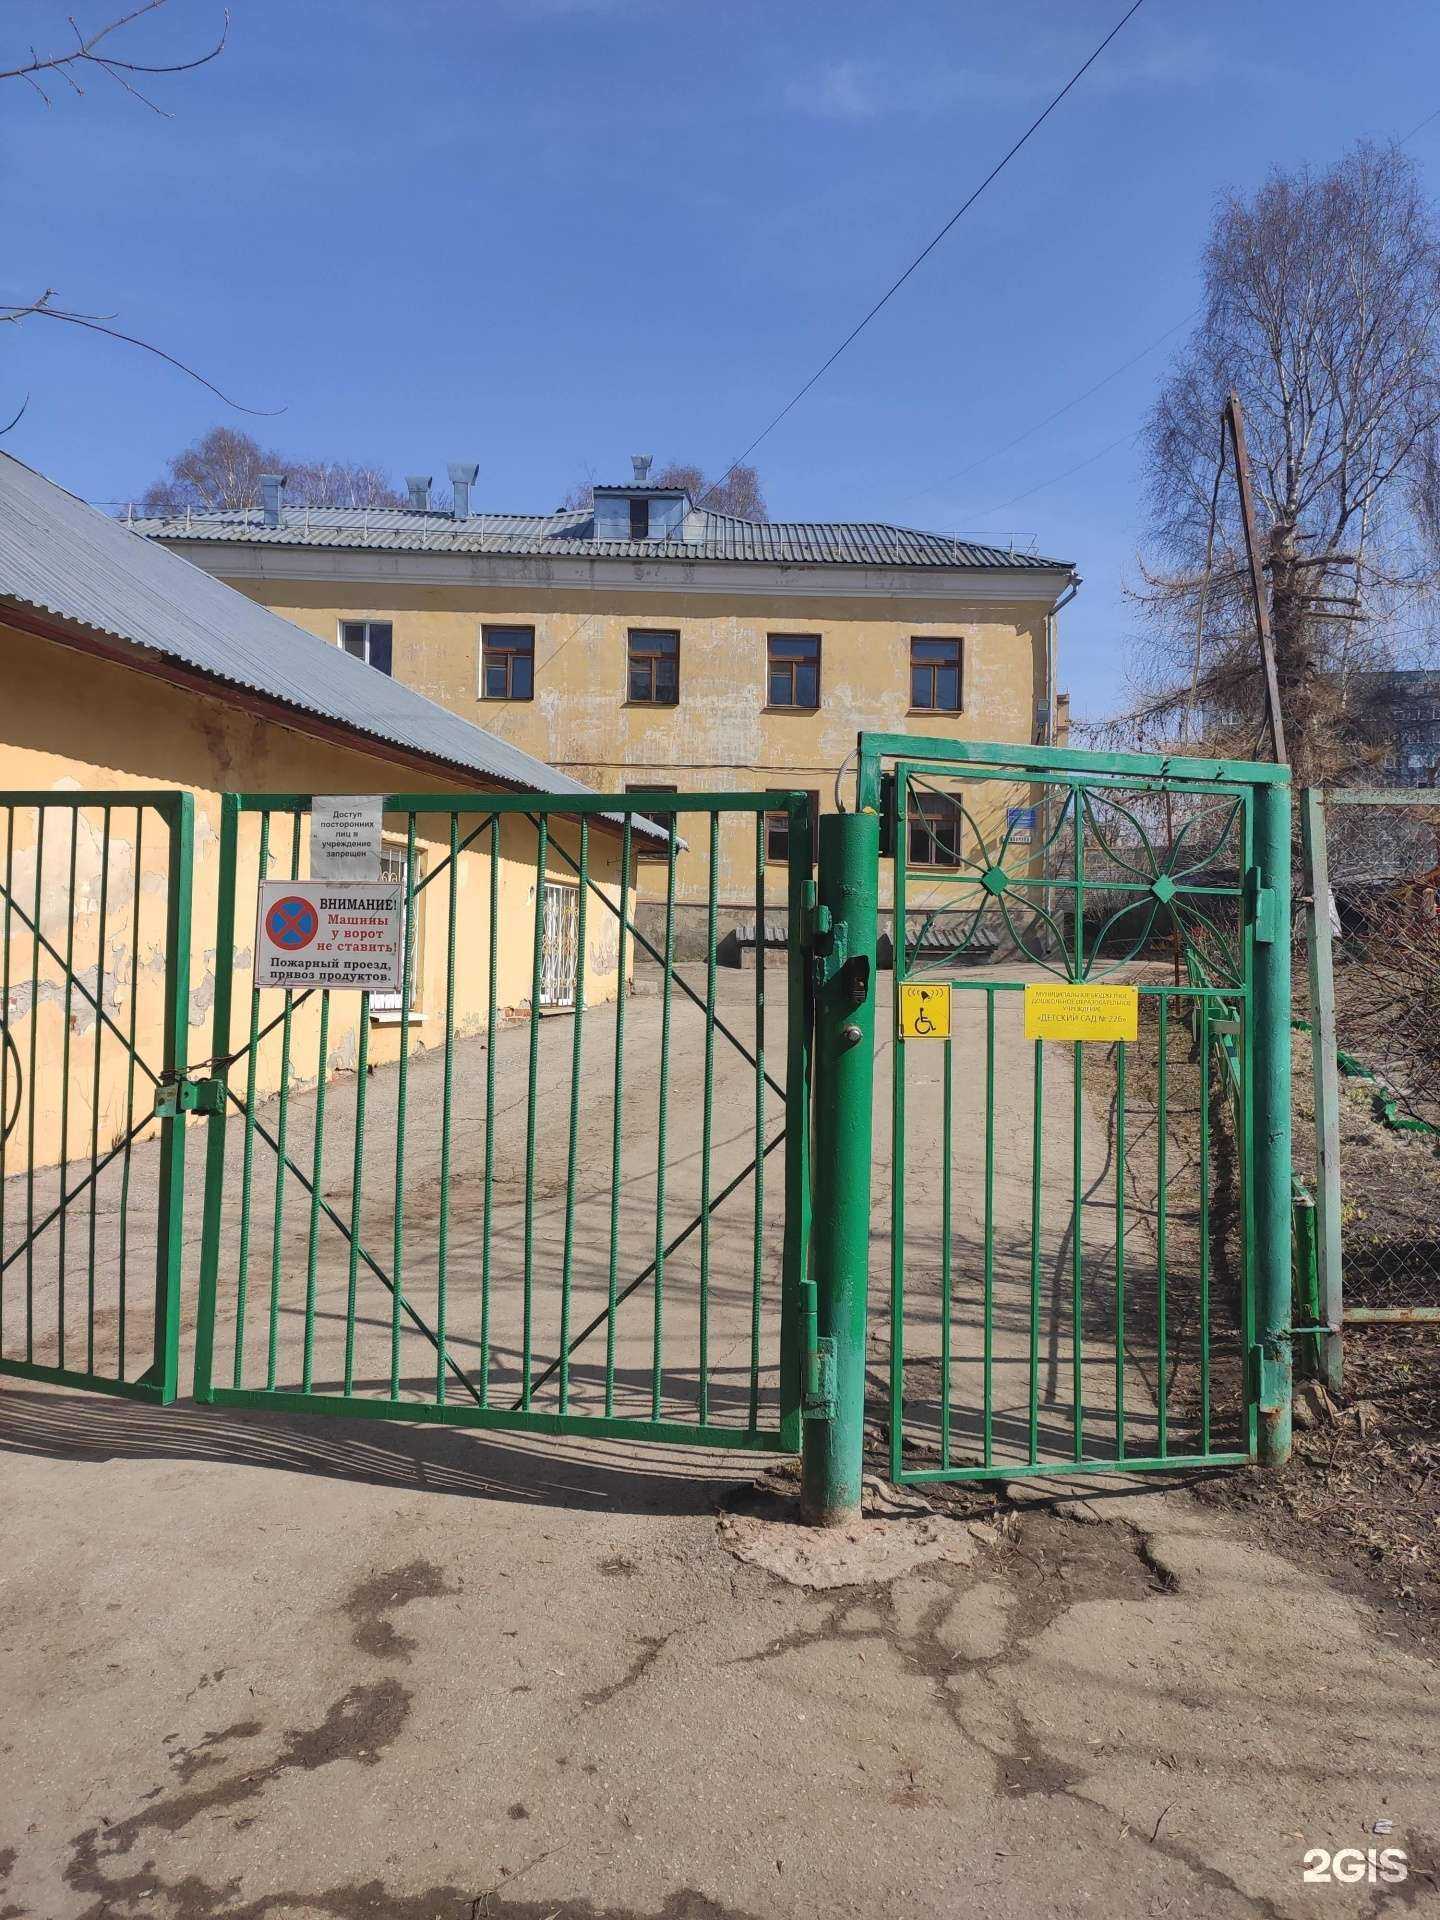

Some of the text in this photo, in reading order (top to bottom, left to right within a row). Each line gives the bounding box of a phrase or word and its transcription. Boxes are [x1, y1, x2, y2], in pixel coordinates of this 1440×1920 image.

[333, 811, 362, 819] Доступ
[320, 821, 374, 829] посторонних
[321, 841, 372, 849] учреждение
[320, 898, 397, 911] ВНИМАНИЕ!
[327, 914, 389, 926] Машины
[331, 930, 385, 940] у ворот
[317, 942, 397, 953] не ставить!
[270, 957, 392, 971] Пожарный проезд,
[270, 970, 391, 982] привоз продуктов.
[1080, 1014, 1096, 1023] САД
